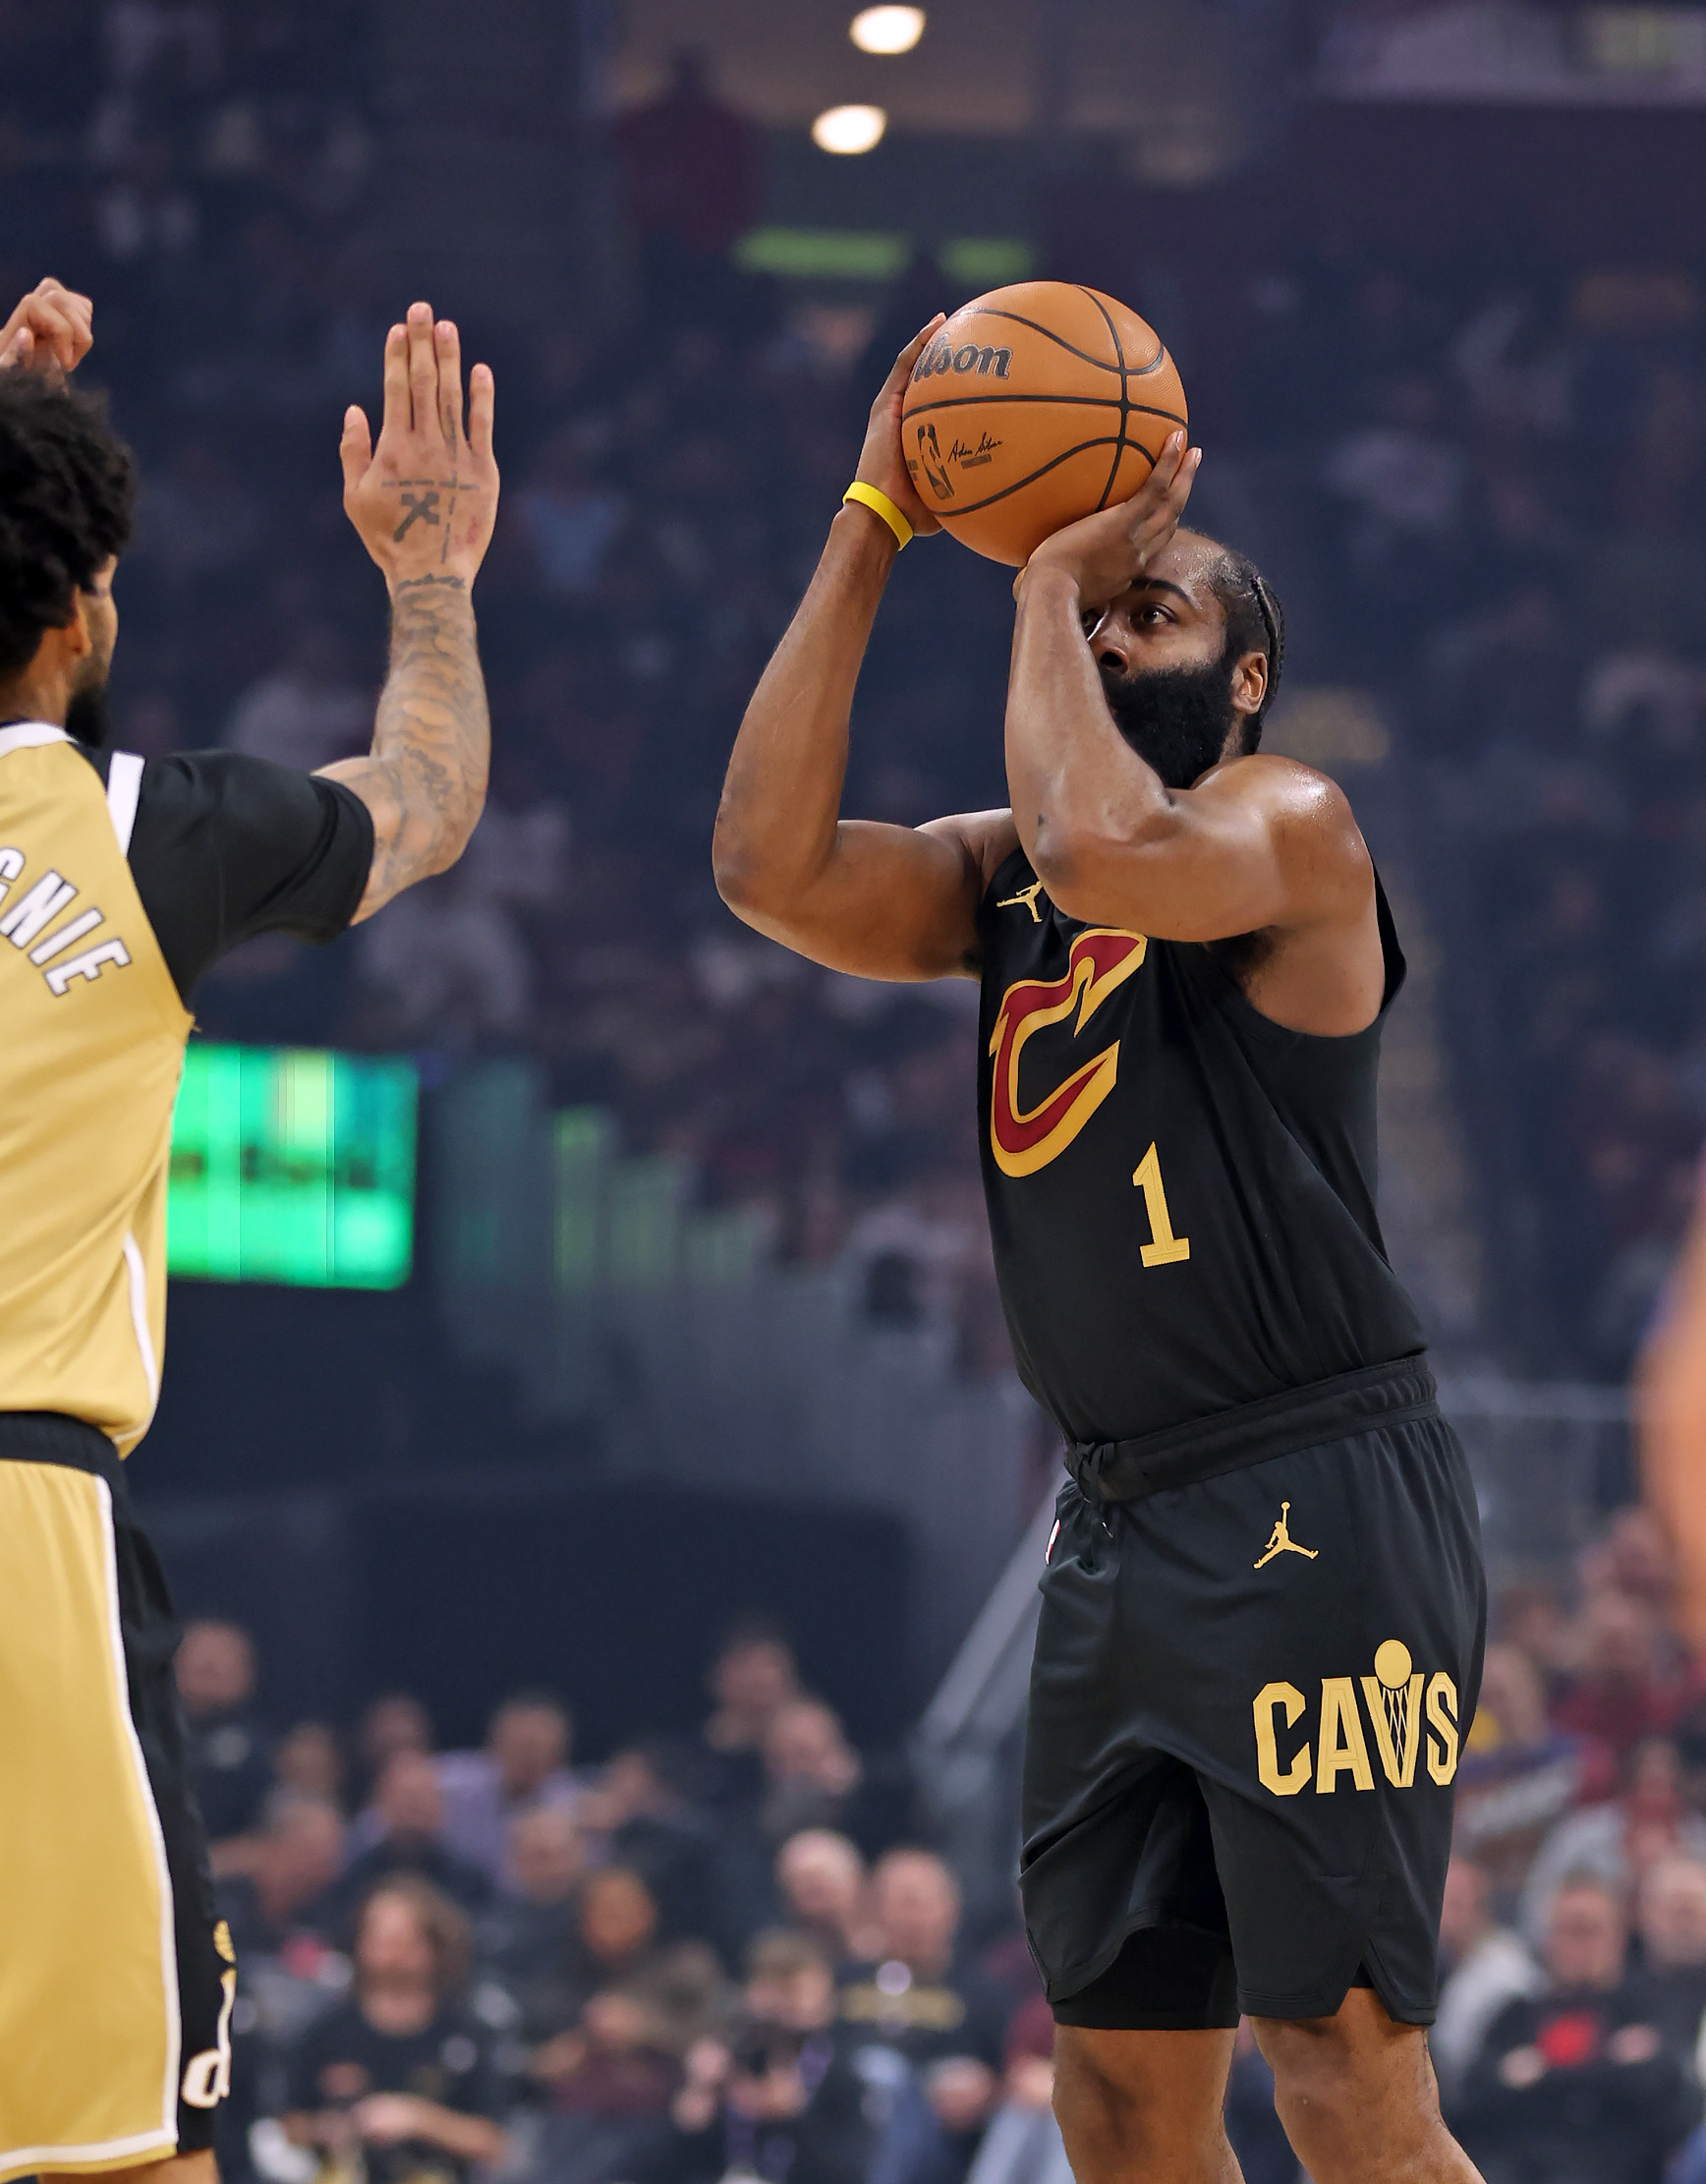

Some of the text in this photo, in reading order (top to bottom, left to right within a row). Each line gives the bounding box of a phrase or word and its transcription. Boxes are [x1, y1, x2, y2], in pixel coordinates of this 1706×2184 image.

[908, 332, 1013, 381] ilson
[1132, 1140, 1190, 1268] 1
[1252, 1671, 1459, 1797] CAVS
